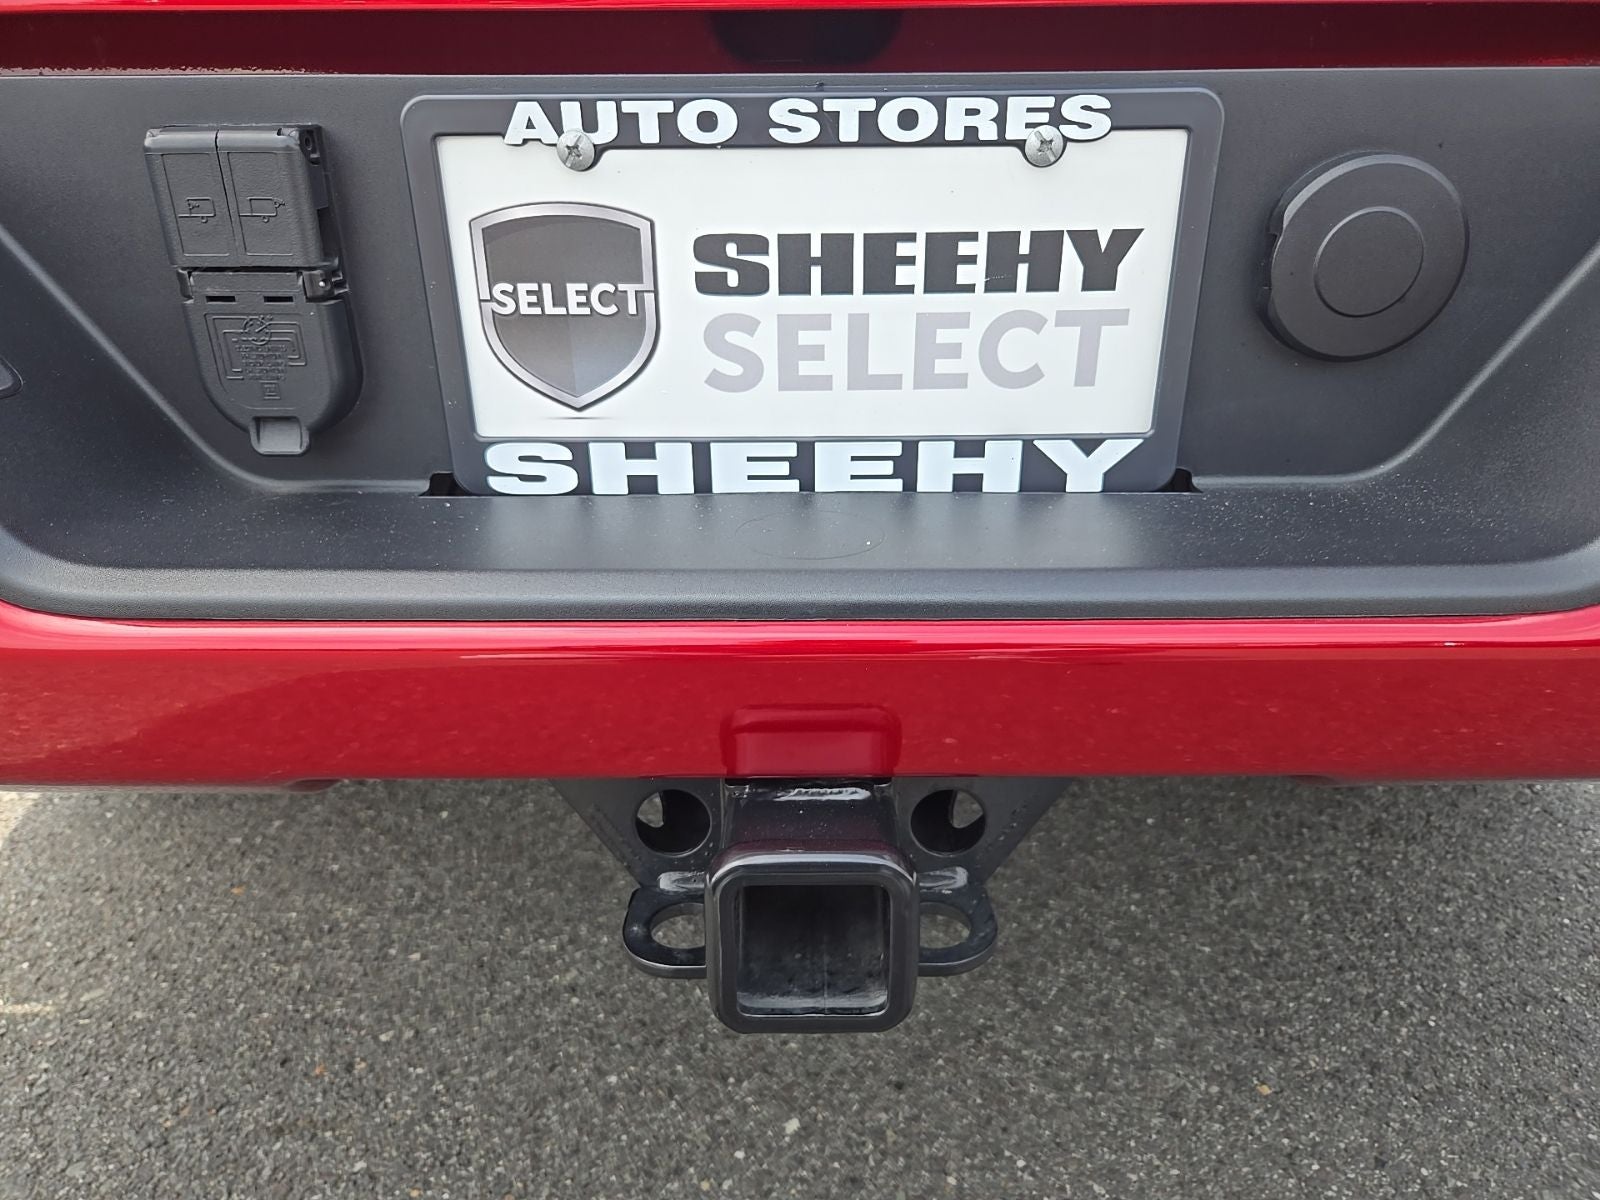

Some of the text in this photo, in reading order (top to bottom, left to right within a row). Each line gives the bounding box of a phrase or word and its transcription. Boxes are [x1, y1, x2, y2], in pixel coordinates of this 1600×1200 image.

[503, 94, 1112, 145] AUTO STORES
[693, 228, 1145, 296] SHEEHY
[490, 282, 644, 316] SELECT
[703, 308, 1130, 393] SELECT
[484, 439, 1144, 496] SHEEHY
